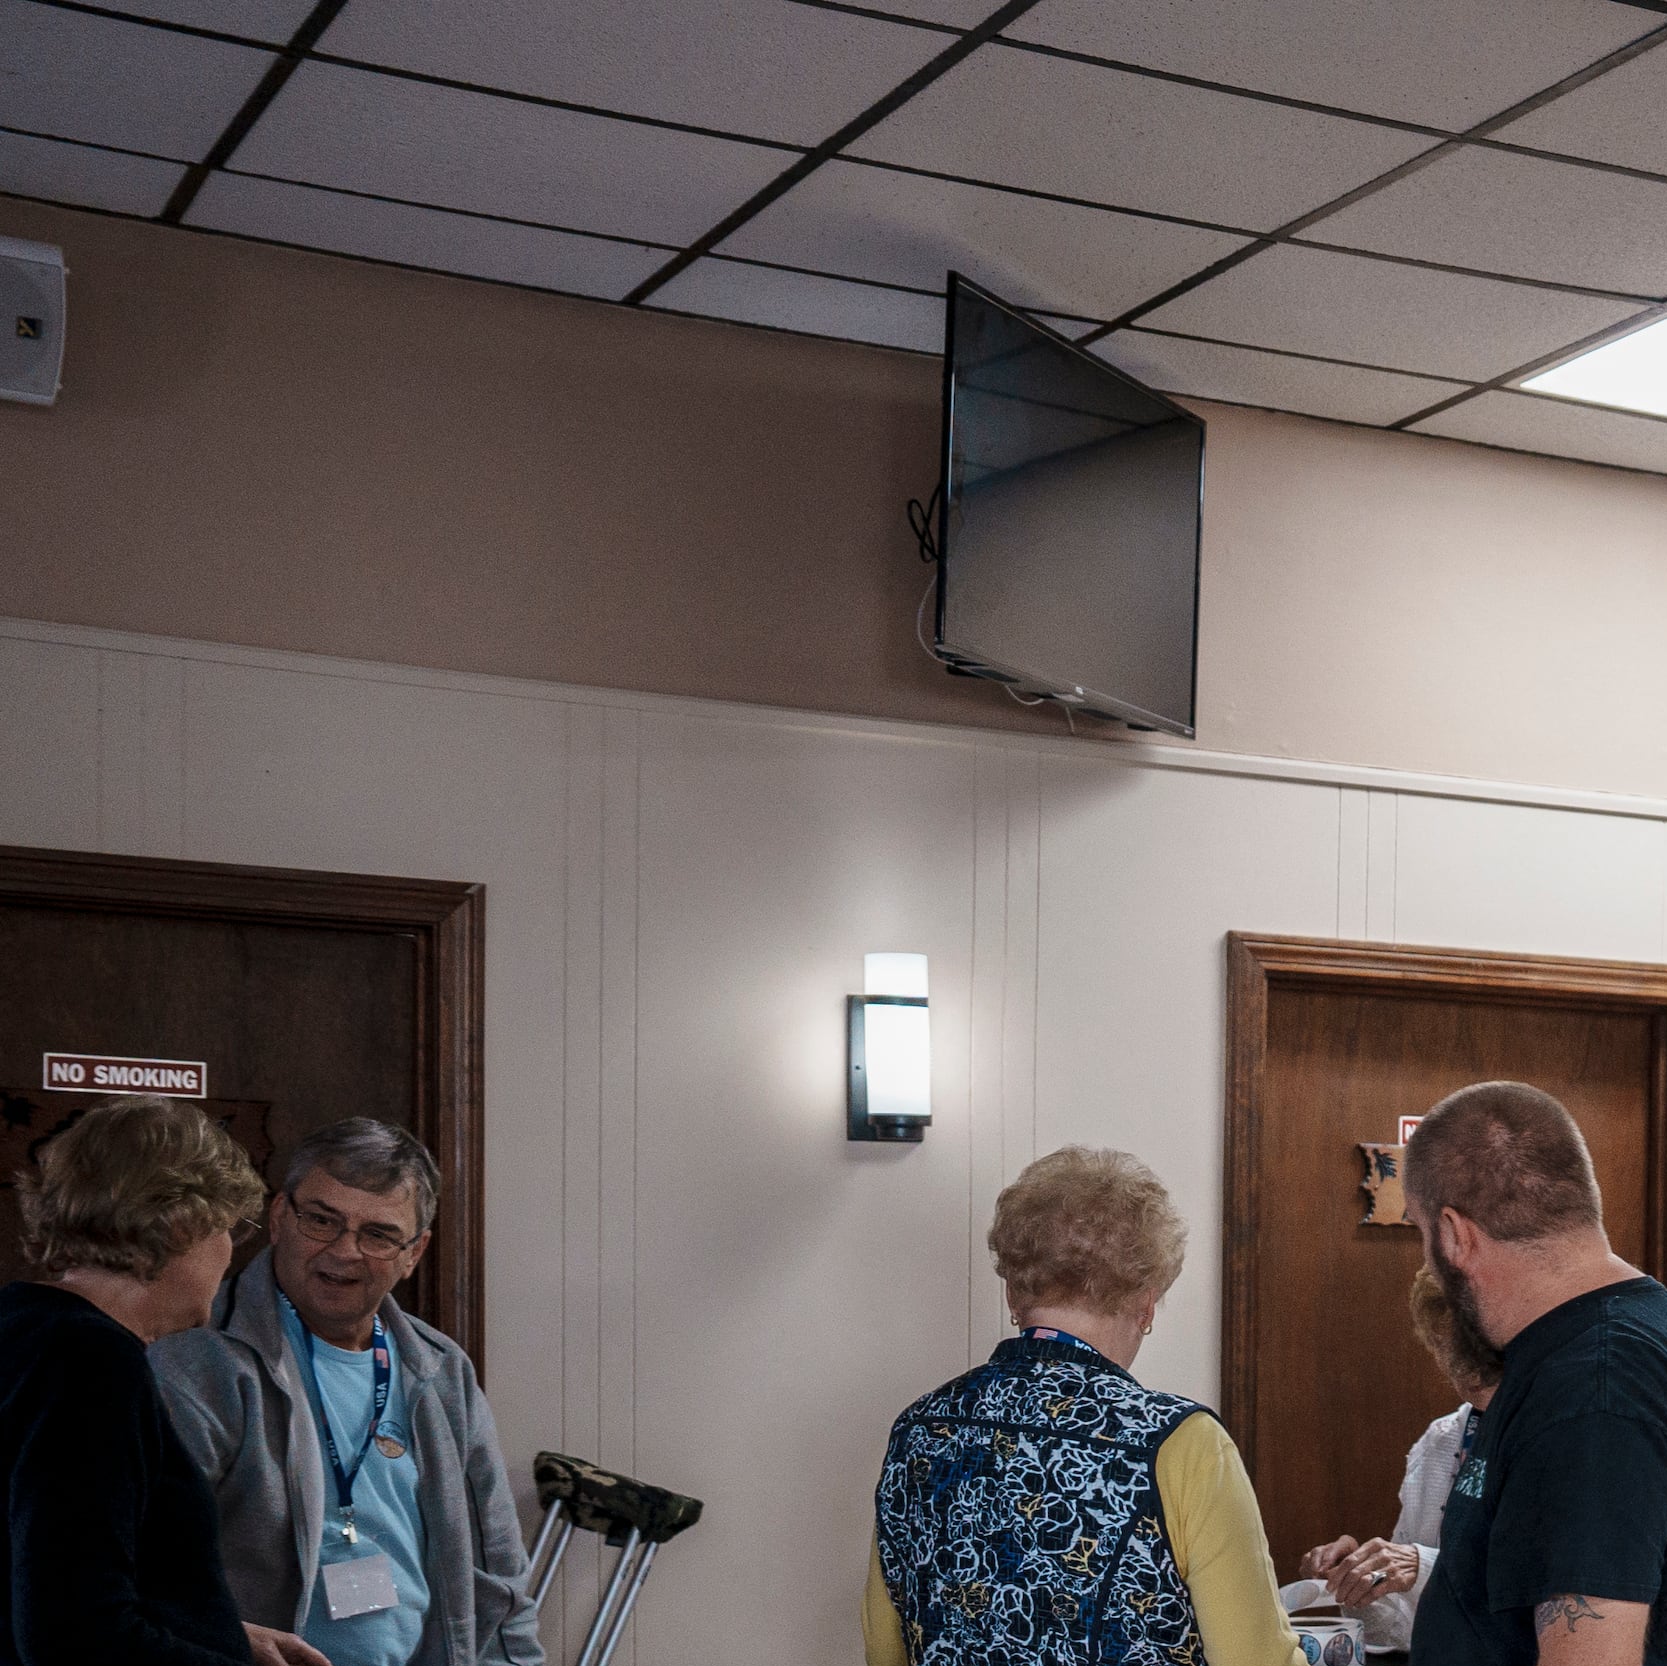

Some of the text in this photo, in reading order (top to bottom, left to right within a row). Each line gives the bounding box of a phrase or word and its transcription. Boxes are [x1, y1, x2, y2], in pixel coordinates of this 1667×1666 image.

[52, 1063, 199, 1090] NO SMOKING
[376, 1382, 388, 1408] USA
[1466, 1415, 1480, 1436] USA
